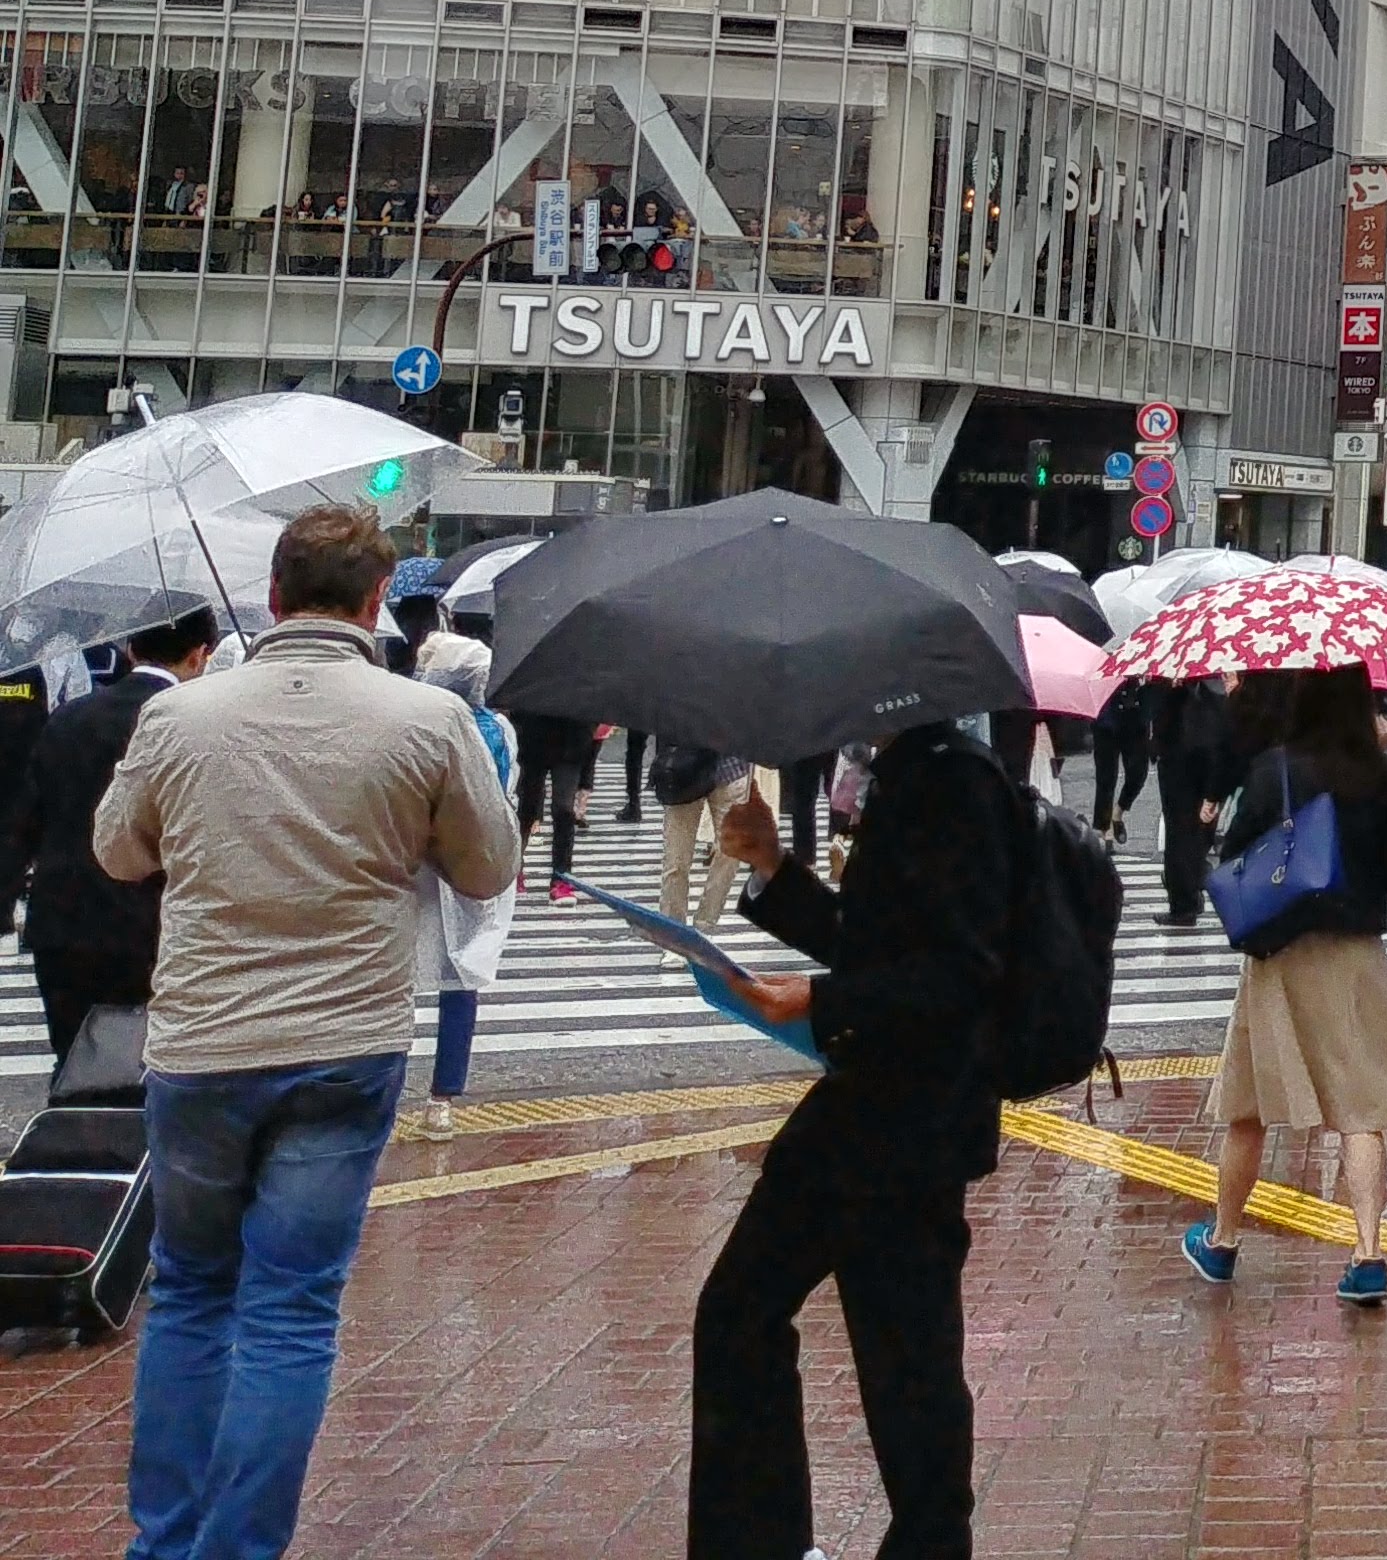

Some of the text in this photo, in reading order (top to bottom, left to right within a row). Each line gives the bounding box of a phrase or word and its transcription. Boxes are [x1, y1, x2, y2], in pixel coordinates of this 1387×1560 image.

[1041, 156, 1190, 238] TSUTAYA
[1344, 292, 1384, 300] TSUTAYA
[498, 293, 874, 367] TSUTAYA
[1348, 311, 1377, 342] 本
[1344, 377, 1376, 387] WIRED
[1053, 474, 1103, 486] COFFE
[1231, 459, 1284, 487] TSUTAYA
[875, 693, 921, 714] GRASS
